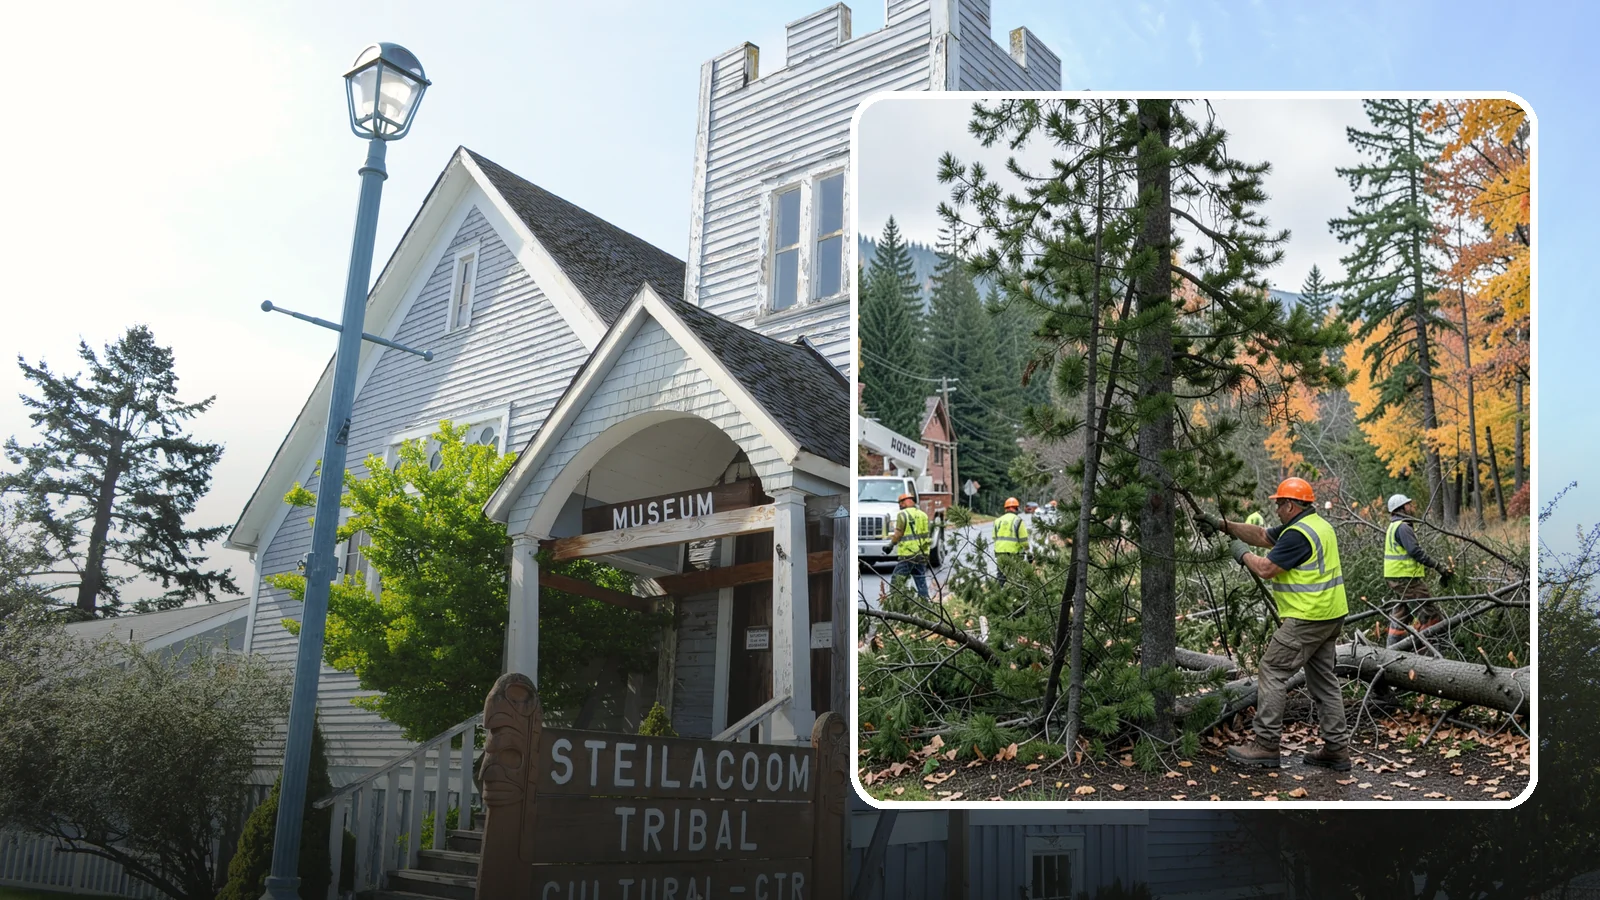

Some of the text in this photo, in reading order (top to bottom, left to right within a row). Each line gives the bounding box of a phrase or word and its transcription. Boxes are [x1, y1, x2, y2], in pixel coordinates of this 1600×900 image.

[612, 491, 714, 530] MUSEUM
[551, 738, 809, 792] STEILACOOM
[615, 807, 757, 852] TRIBAL
